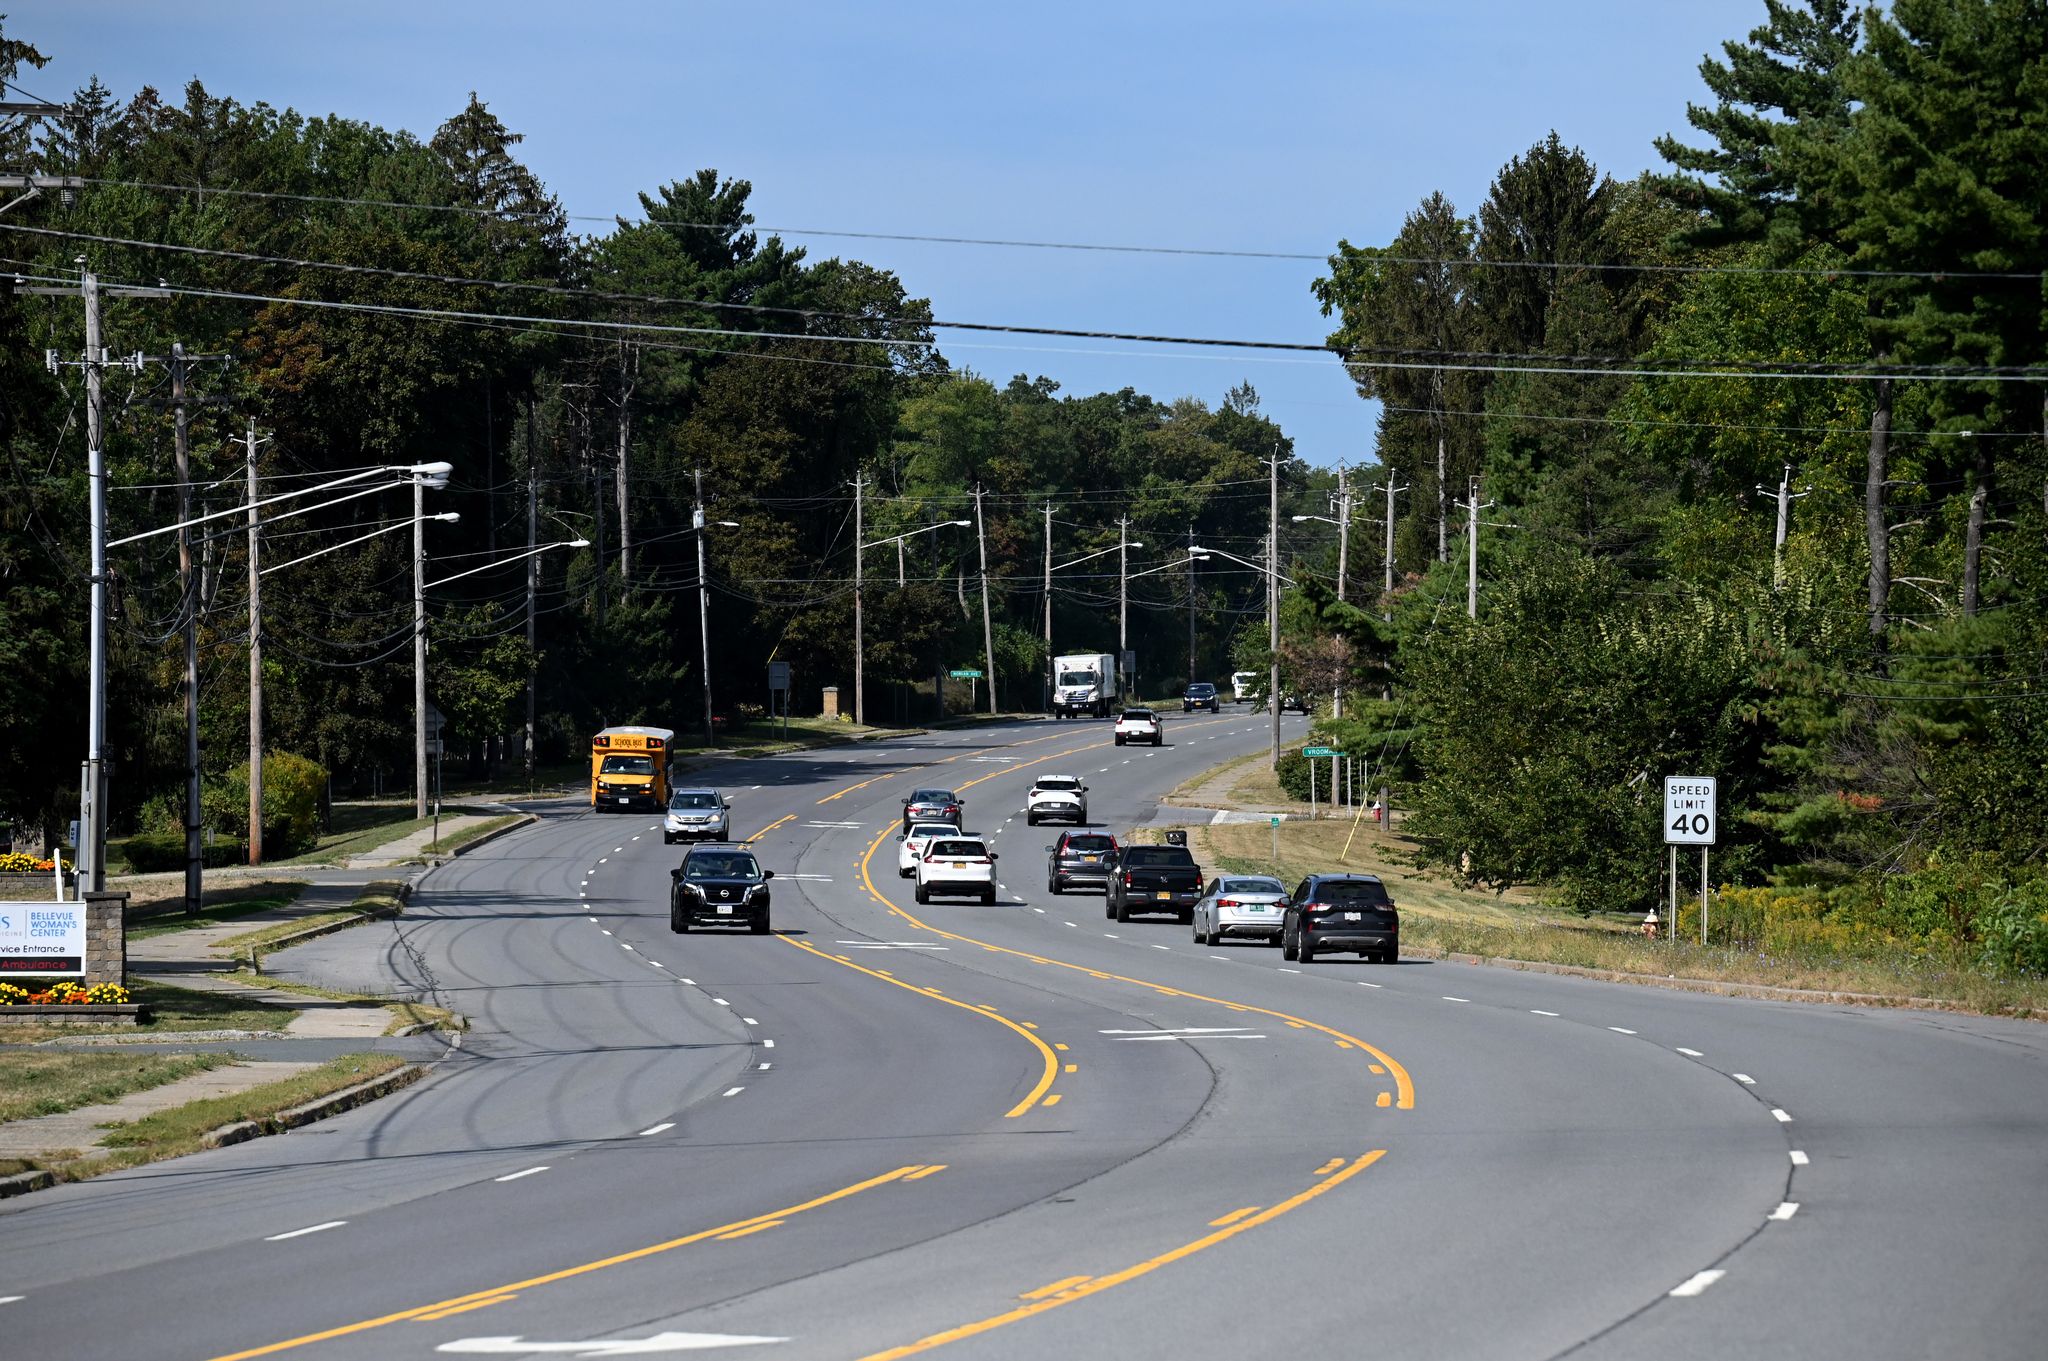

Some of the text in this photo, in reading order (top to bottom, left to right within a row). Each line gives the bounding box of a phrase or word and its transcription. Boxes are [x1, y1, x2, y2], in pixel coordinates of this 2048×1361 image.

[614, 738, 642, 747] SCHOOL BUS
[1670, 785, 1710, 795] SPEED
[1674, 799, 1706, 809] LIMIT
[1671, 813, 1709, 835] 40
[30, 912, 74, 921] BELLEVUE
[30, 920, 77, 929] WOMAN'S
[30, 928, 66, 937] CENTER
[0, 945, 65, 953] vice Entrance
[1, 960, 67, 969] Ambulance
